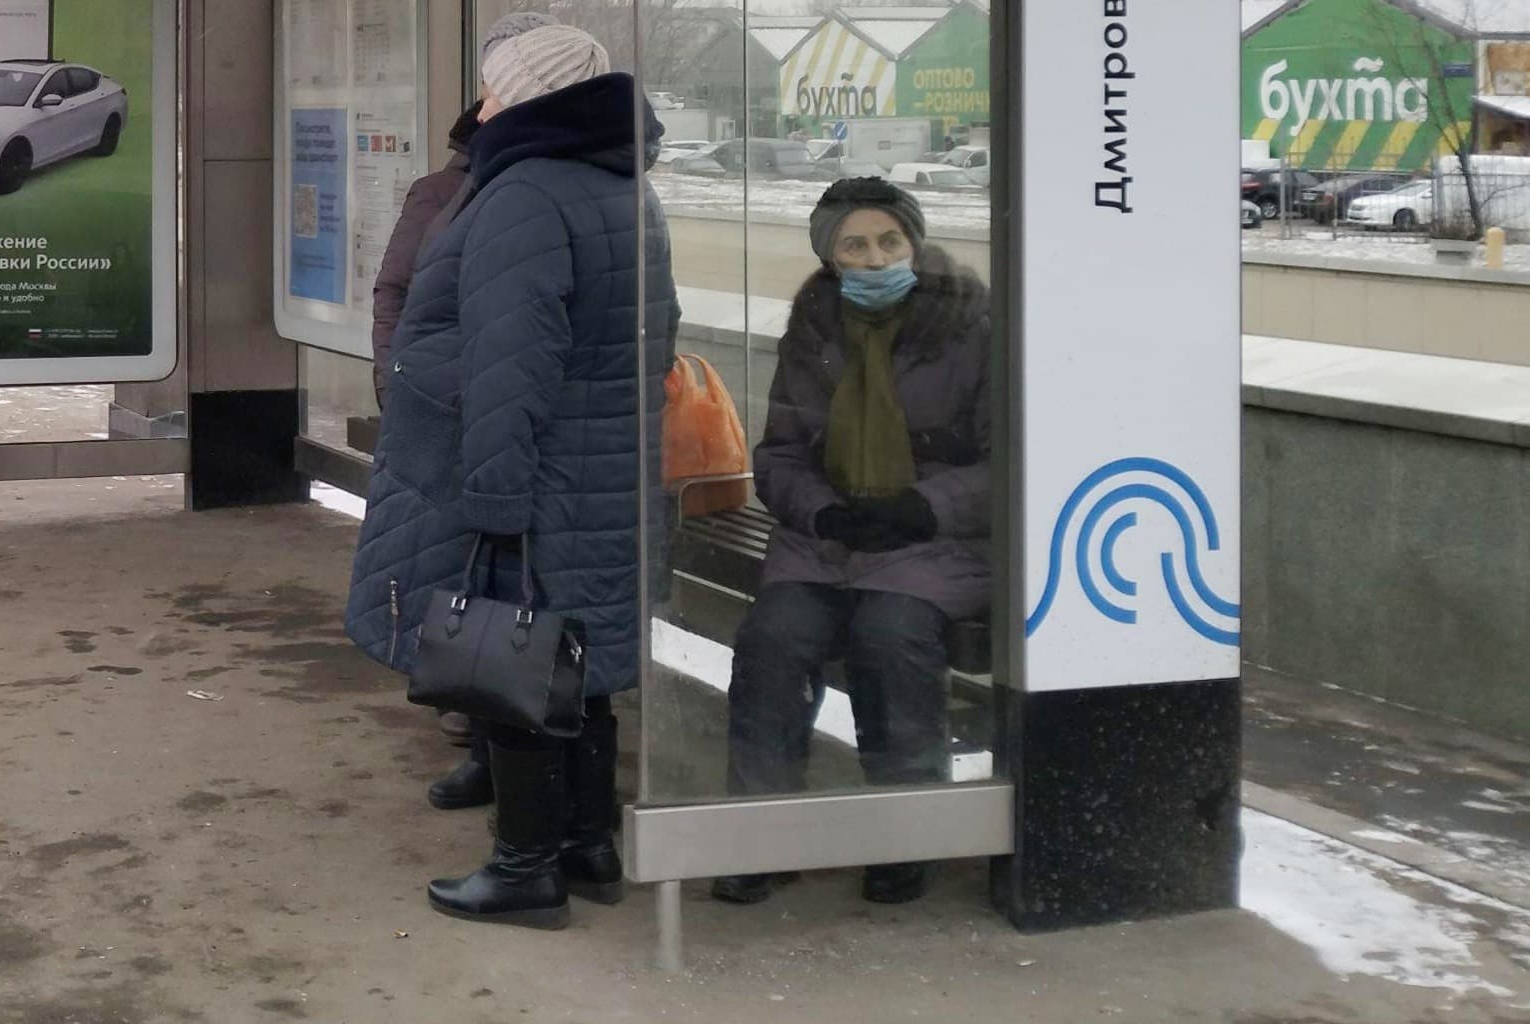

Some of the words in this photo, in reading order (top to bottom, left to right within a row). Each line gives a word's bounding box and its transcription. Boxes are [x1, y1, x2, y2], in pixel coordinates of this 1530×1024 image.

[36, 255, 112, 271] России»
[18, 282, 57, 291] Москвы
[11, 293, 45, 303] удобно
